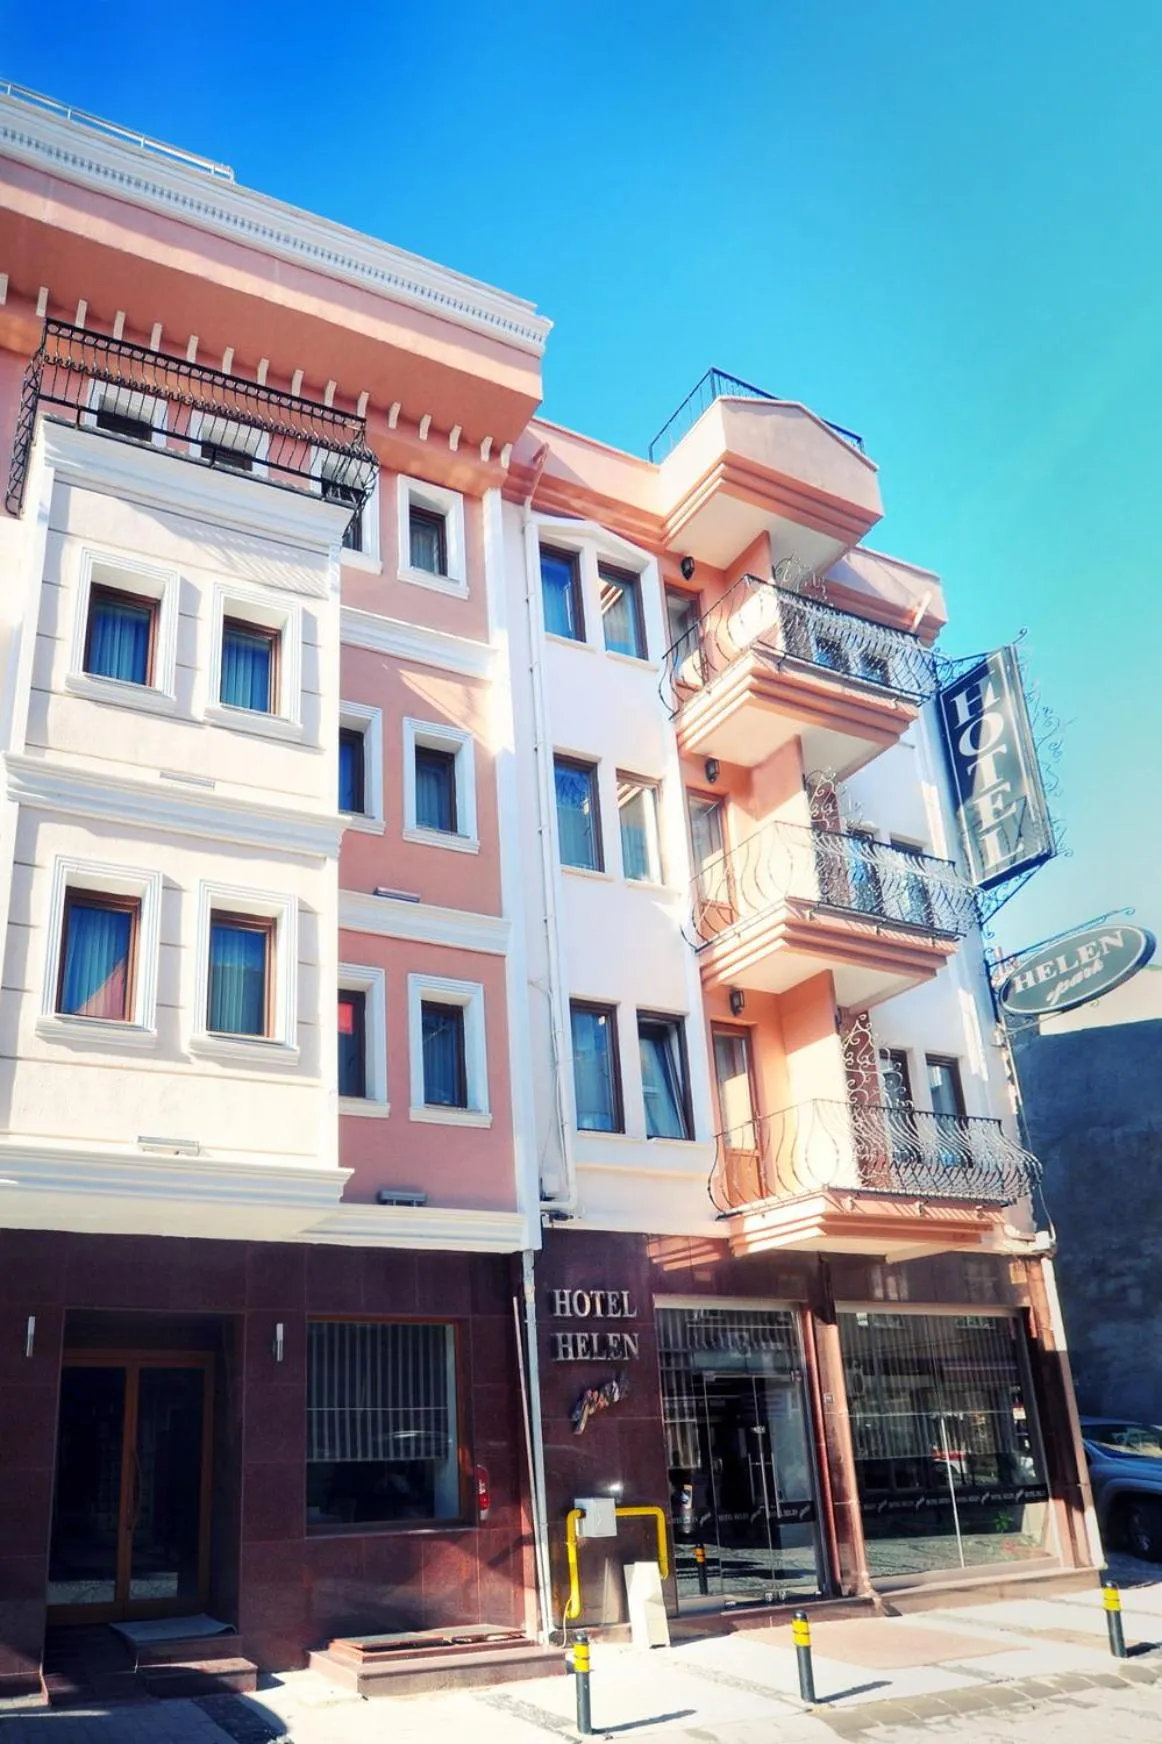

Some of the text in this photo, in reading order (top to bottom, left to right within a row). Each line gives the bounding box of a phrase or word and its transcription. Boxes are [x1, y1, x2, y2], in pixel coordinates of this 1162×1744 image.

[951, 670, 1025, 867] HOTEL
[1014, 930, 1125, 993] HELEN
[552, 1289, 638, 1318] HOTEL
[555, 1332, 640, 1361] HELEN
